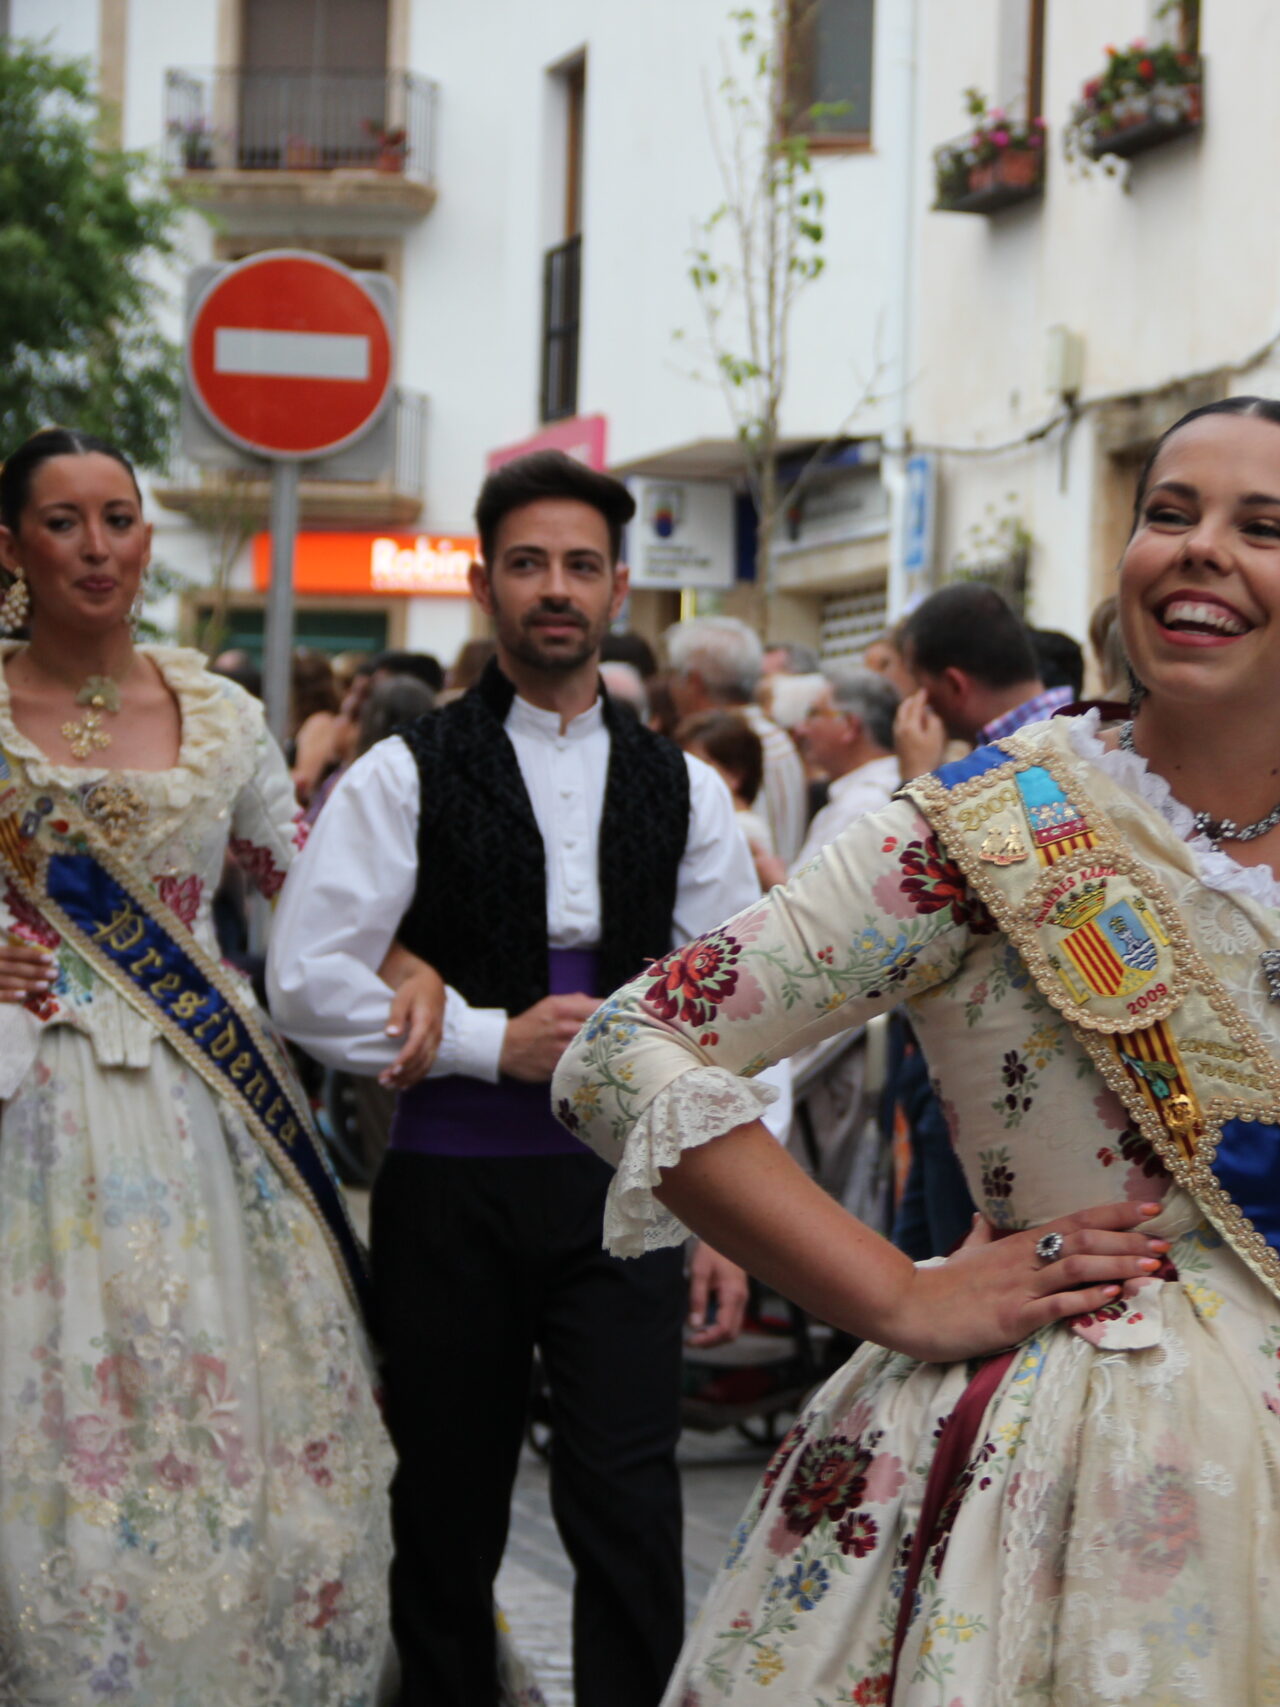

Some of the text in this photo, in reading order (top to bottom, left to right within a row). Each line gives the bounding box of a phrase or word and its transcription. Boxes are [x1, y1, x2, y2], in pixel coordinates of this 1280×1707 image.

[957, 786, 1020, 832] 2009
[1126, 982, 1168, 1016] 2009
[92, 902, 298, 1146] Presidenta
